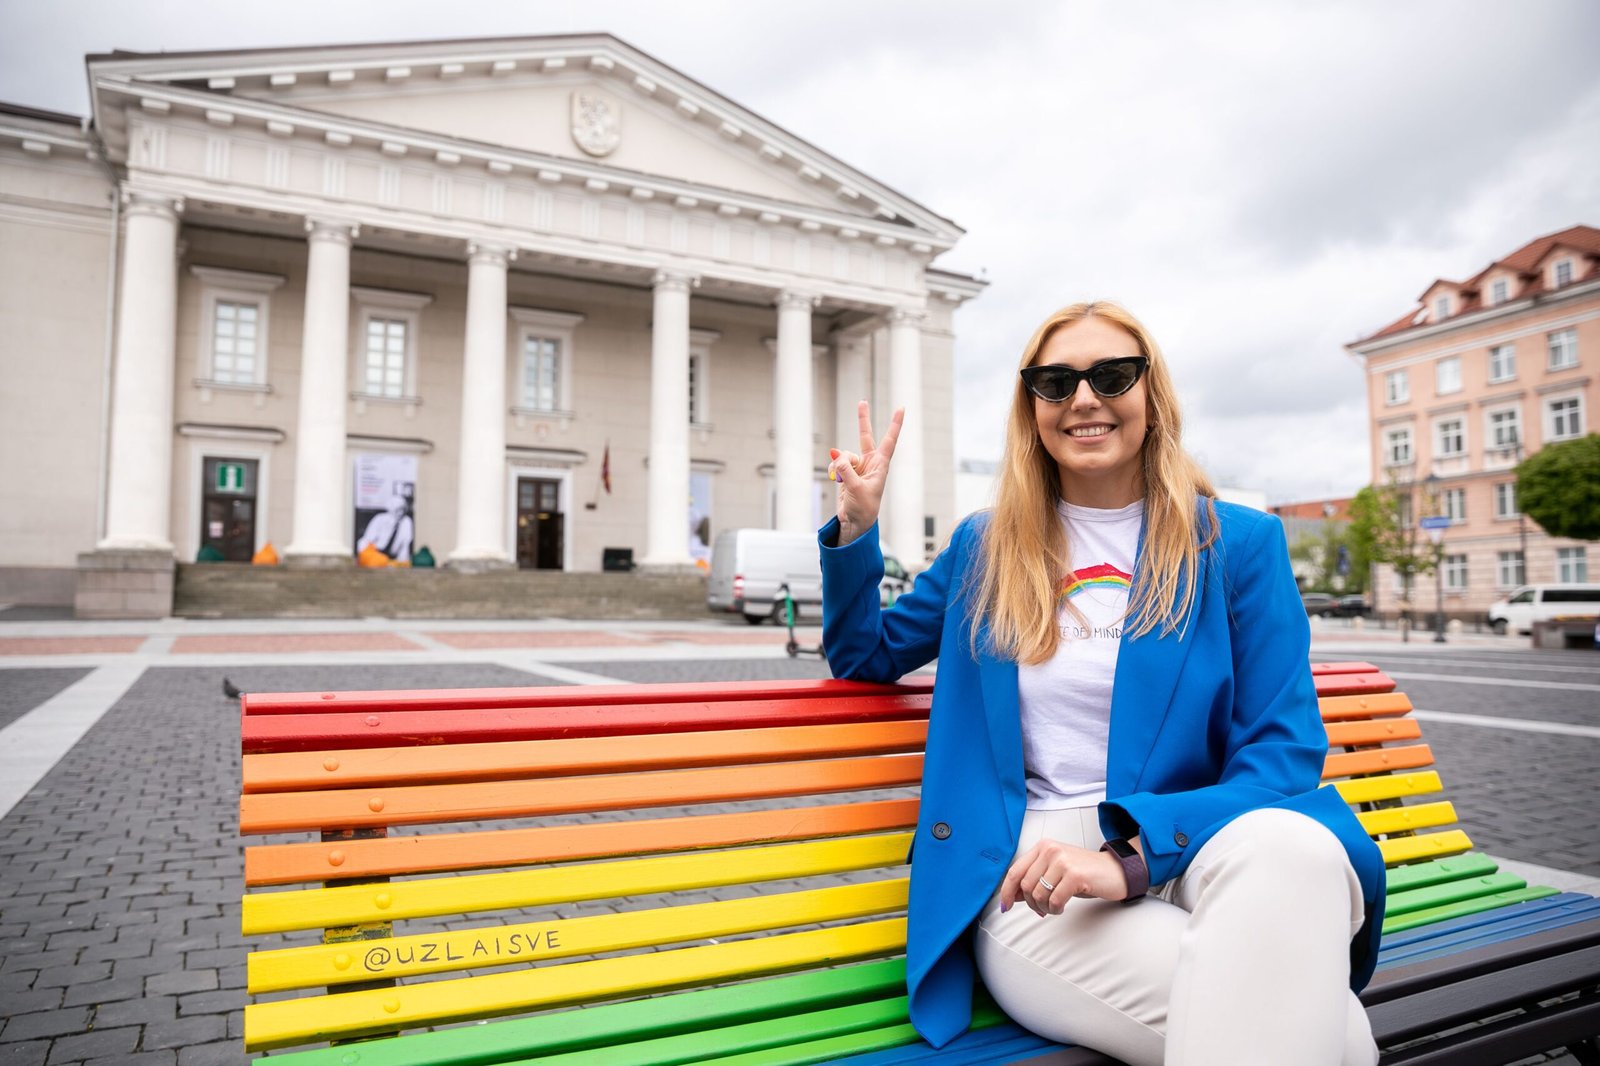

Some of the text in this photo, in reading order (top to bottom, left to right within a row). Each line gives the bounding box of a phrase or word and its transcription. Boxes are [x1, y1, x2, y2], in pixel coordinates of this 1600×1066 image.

[1073, 626, 1086, 638] OF
[1094, 627, 1123, 639] MIND
[364, 930, 561, 972] @UZLAISVE
